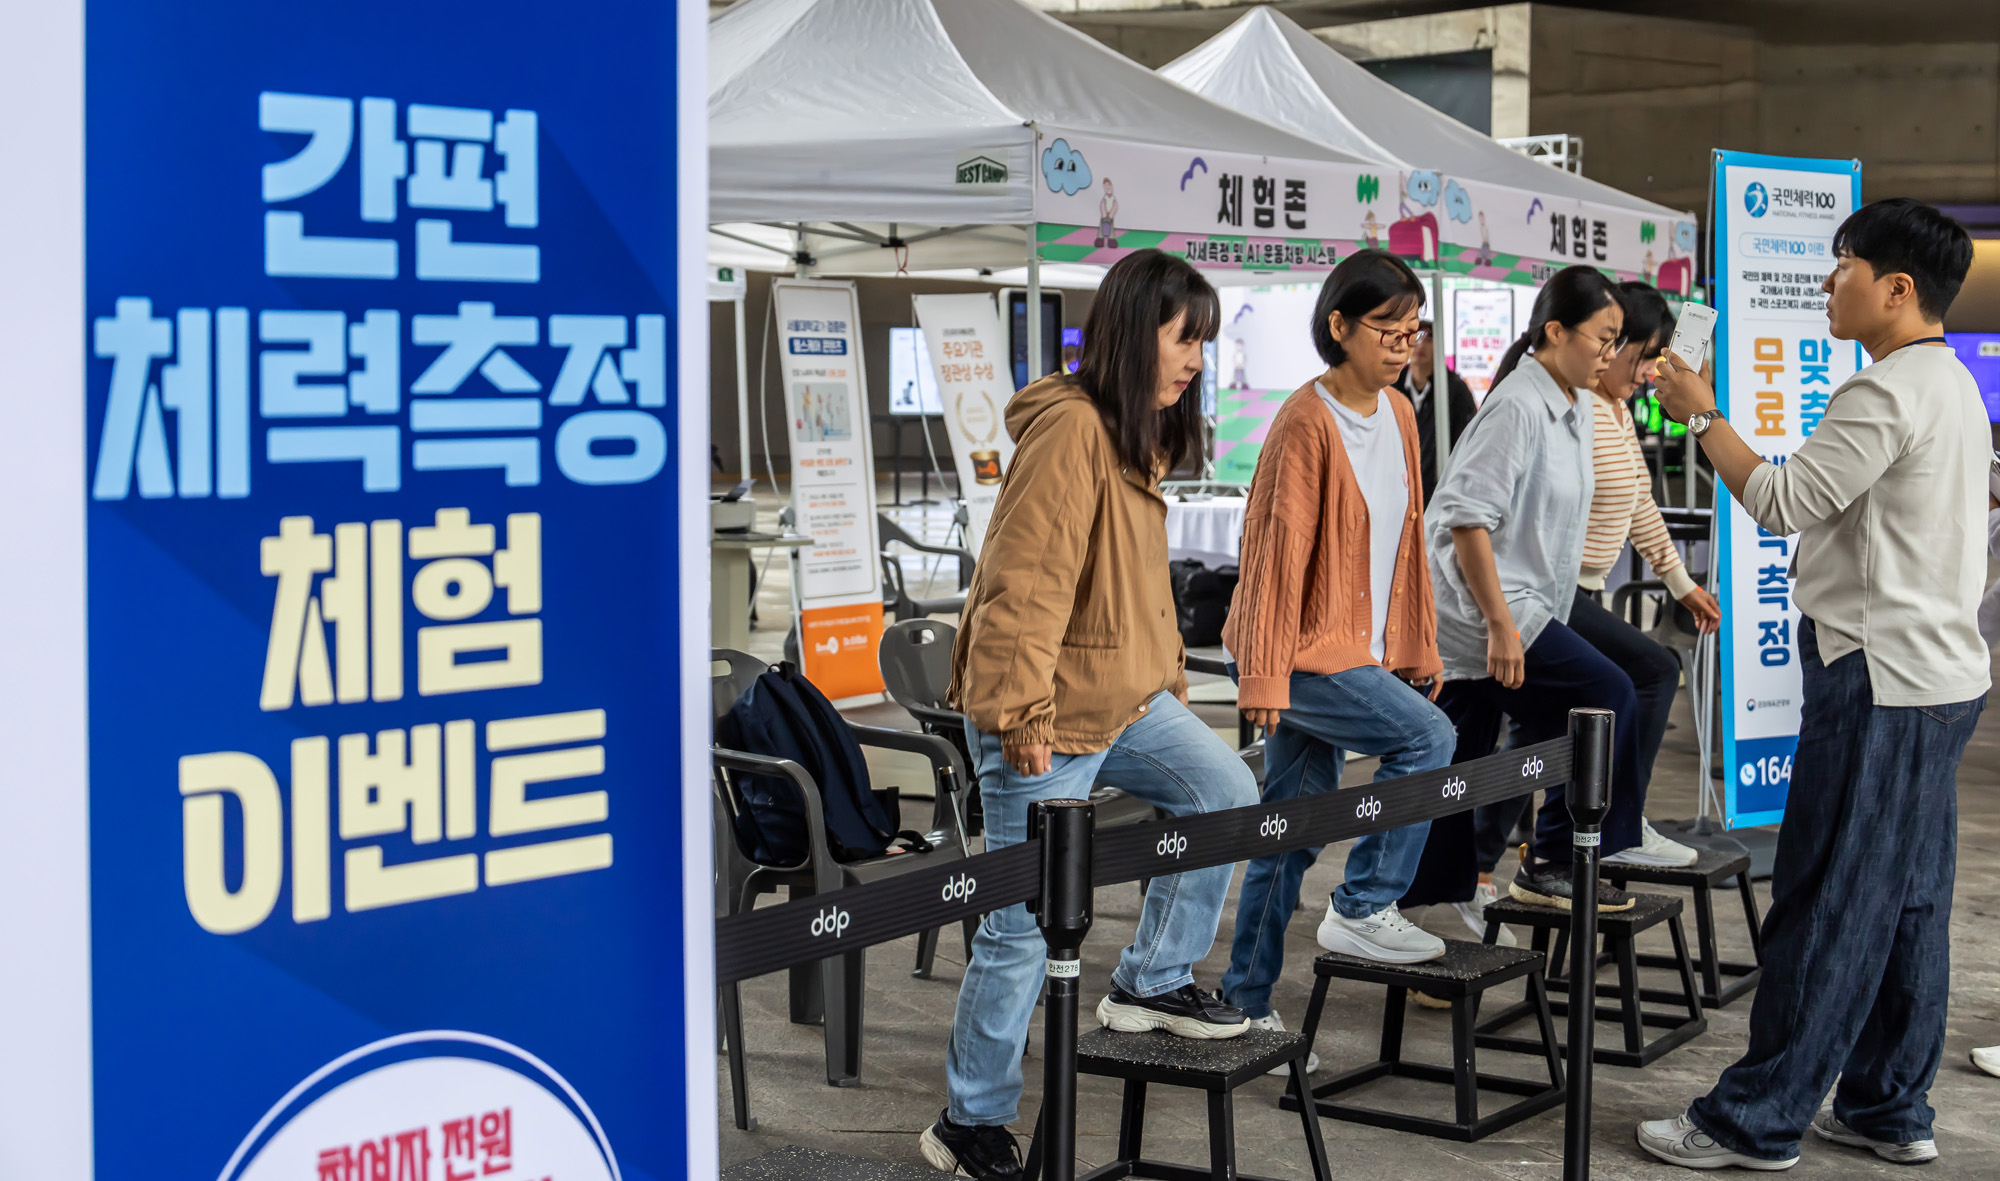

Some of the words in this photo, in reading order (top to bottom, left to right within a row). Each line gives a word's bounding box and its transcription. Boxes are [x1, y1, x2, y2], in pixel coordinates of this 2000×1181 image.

[258, 91, 541, 283] 간편
[958, 163, 981, 183] BEST
[1217, 172, 1307, 230] 체험존
[1771, 187, 1835, 209] 국민체력100
[1185, 240, 1230, 263] 자세측정
[1232, 242, 1244, 263] 및
[1247, 243, 1260, 264] AI
[1263, 243, 1304, 265] 운동처방
[1306, 245, 1337, 265] 시스템
[1550, 212, 1607, 261] 체험존
[1752, 238, 1806, 255] 국민체력100
[1807, 242, 1825, 256] 이란
[93, 296, 668, 501] 체력측정
[1753, 337, 1786, 436] 무료
[260, 507, 543, 711] 체험
[178, 708, 614, 936] 이벤트
[1157, 830, 1187, 858] ddp
[1260, 813, 1288, 840] ddp
[1356, 795, 1382, 820] ddp
[1442, 776, 1466, 800] ddp
[1522, 755, 1544, 779] ddp
[811, 905, 850, 938] ddp
[942, 872, 977, 903] ddp
[441, 1106, 512, 1181] 전원
